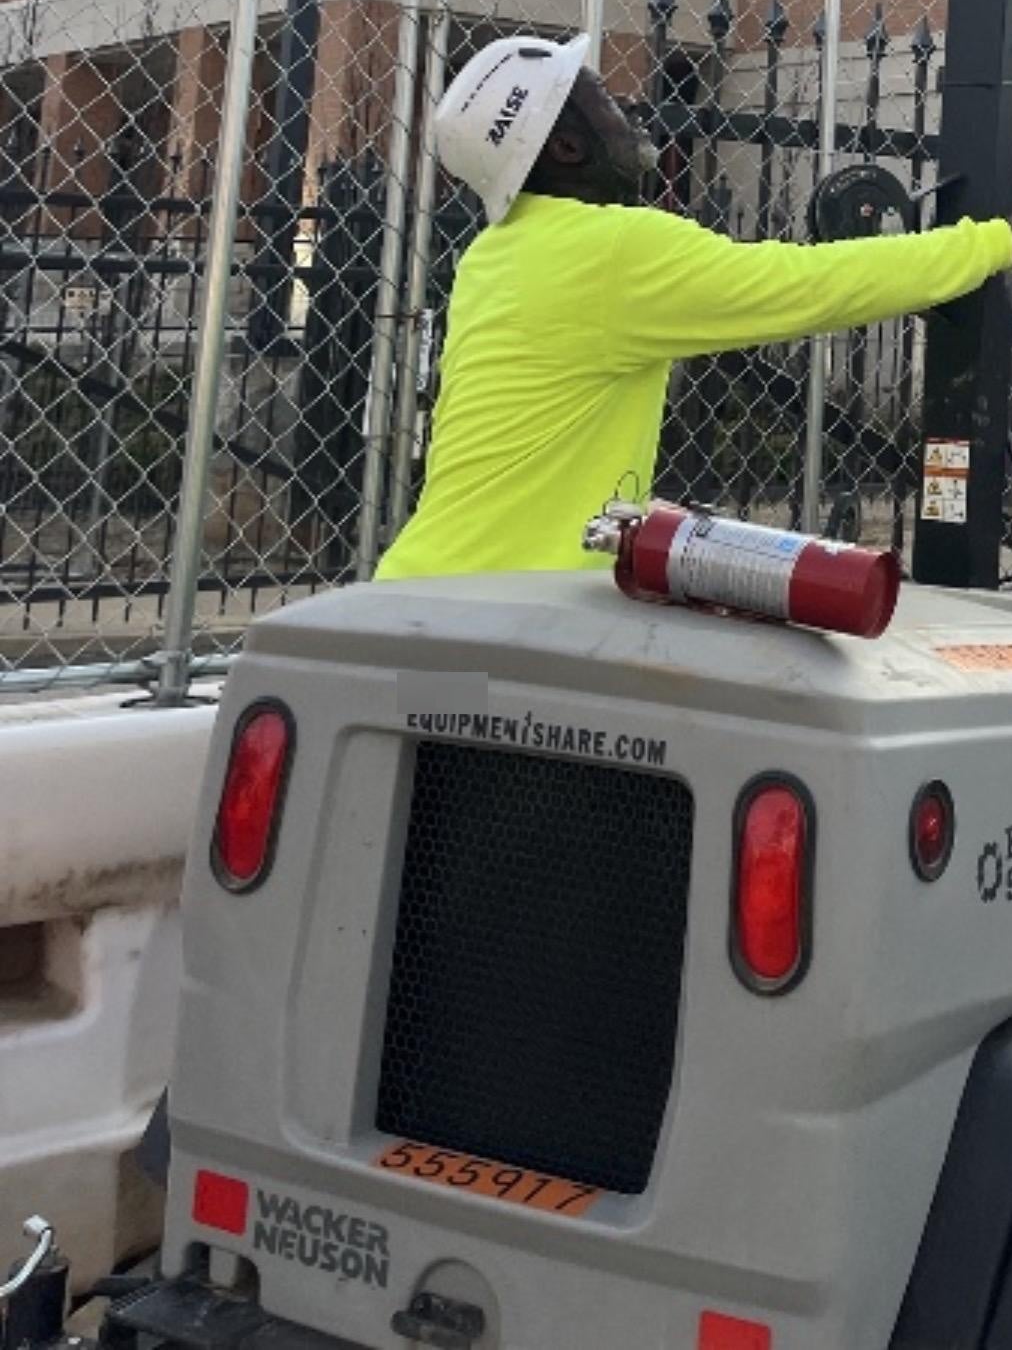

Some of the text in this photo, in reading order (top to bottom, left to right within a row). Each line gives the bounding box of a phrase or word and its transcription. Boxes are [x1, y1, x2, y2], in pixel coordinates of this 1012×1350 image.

[380, 1143, 597, 1212] 555917
[253, 1222, 389, 1289] NEUSON
[256, 1188, 390, 1257] WACKER
